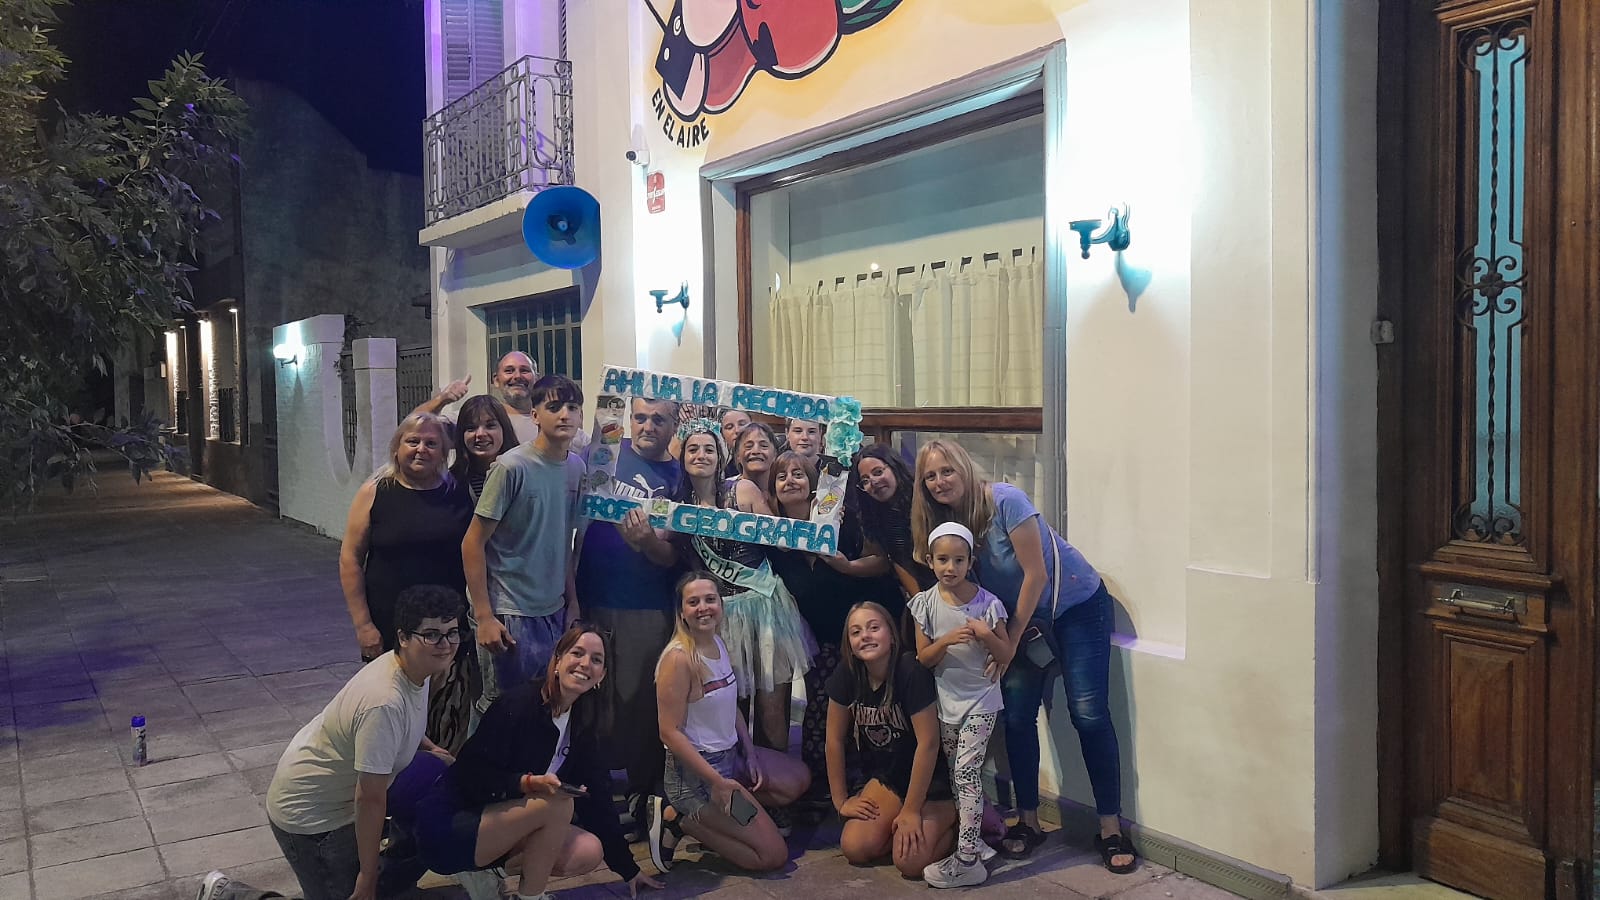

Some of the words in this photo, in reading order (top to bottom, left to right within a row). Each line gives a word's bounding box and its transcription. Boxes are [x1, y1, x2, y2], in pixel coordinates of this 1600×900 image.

[651, 88, 666, 121] EN
[662, 113, 675, 142] EL
[676, 117, 710, 148] AIRE
[651, 373, 682, 401] VA
[691, 380, 719, 405] LA
[732, 385, 830, 421] RECIBIDA
[614, 480, 646, 498] MA
[672, 505, 836, 554] GEOGRAFIA
